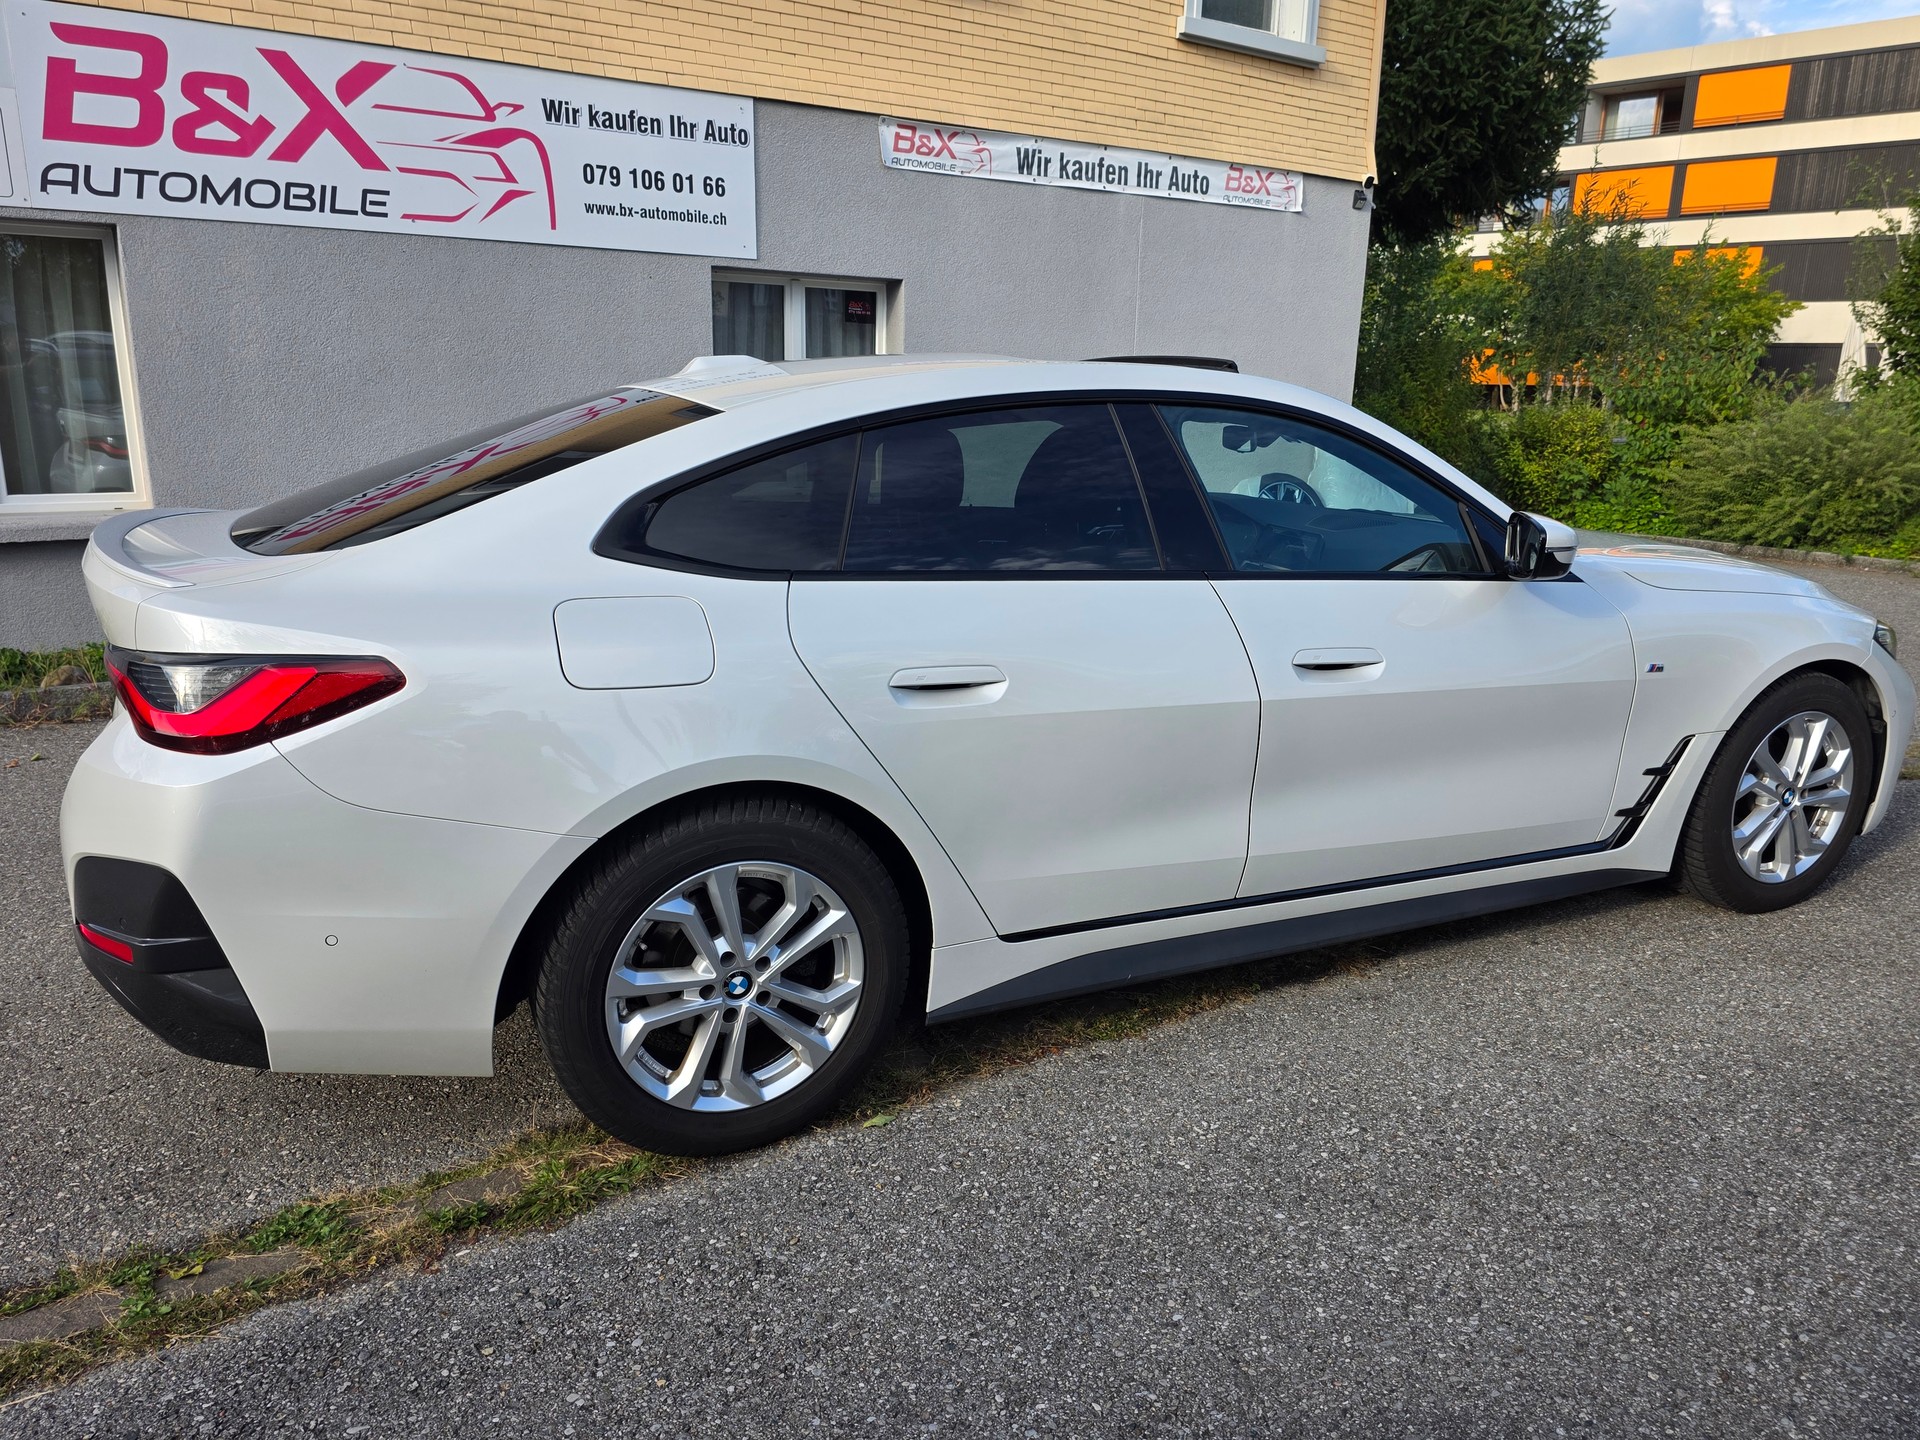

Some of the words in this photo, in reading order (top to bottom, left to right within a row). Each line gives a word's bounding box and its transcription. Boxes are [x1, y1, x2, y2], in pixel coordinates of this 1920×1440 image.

[42, 21, 397, 172] B&X
[541, 98, 580, 126] Wir
[588, 103, 662, 136] kaufen
[669, 114, 697, 140] Ihr
[704, 119, 750, 146] Auto
[892, 123, 960, 160] B&X
[582, 163, 621, 187] 079
[629, 168, 665, 192] 106
[672, 172, 694, 195] 01
[702, 176, 726, 198] 66
[891, 157, 957, 173] AUTOMOBILE
[1016, 146, 1052, 178] Wir
[1059, 152, 1129, 186] kaufen
[1137, 161, 1162, 189] Ihr
[1168, 165, 1210, 195] Auto
[1224, 166, 1275, 197] B&X
[39, 162, 391, 218] AUTOMOBILE
[1222, 194, 1271, 207] AUTOMOBILE
[584, 202, 727, 226] www.bx-automobile.ch
